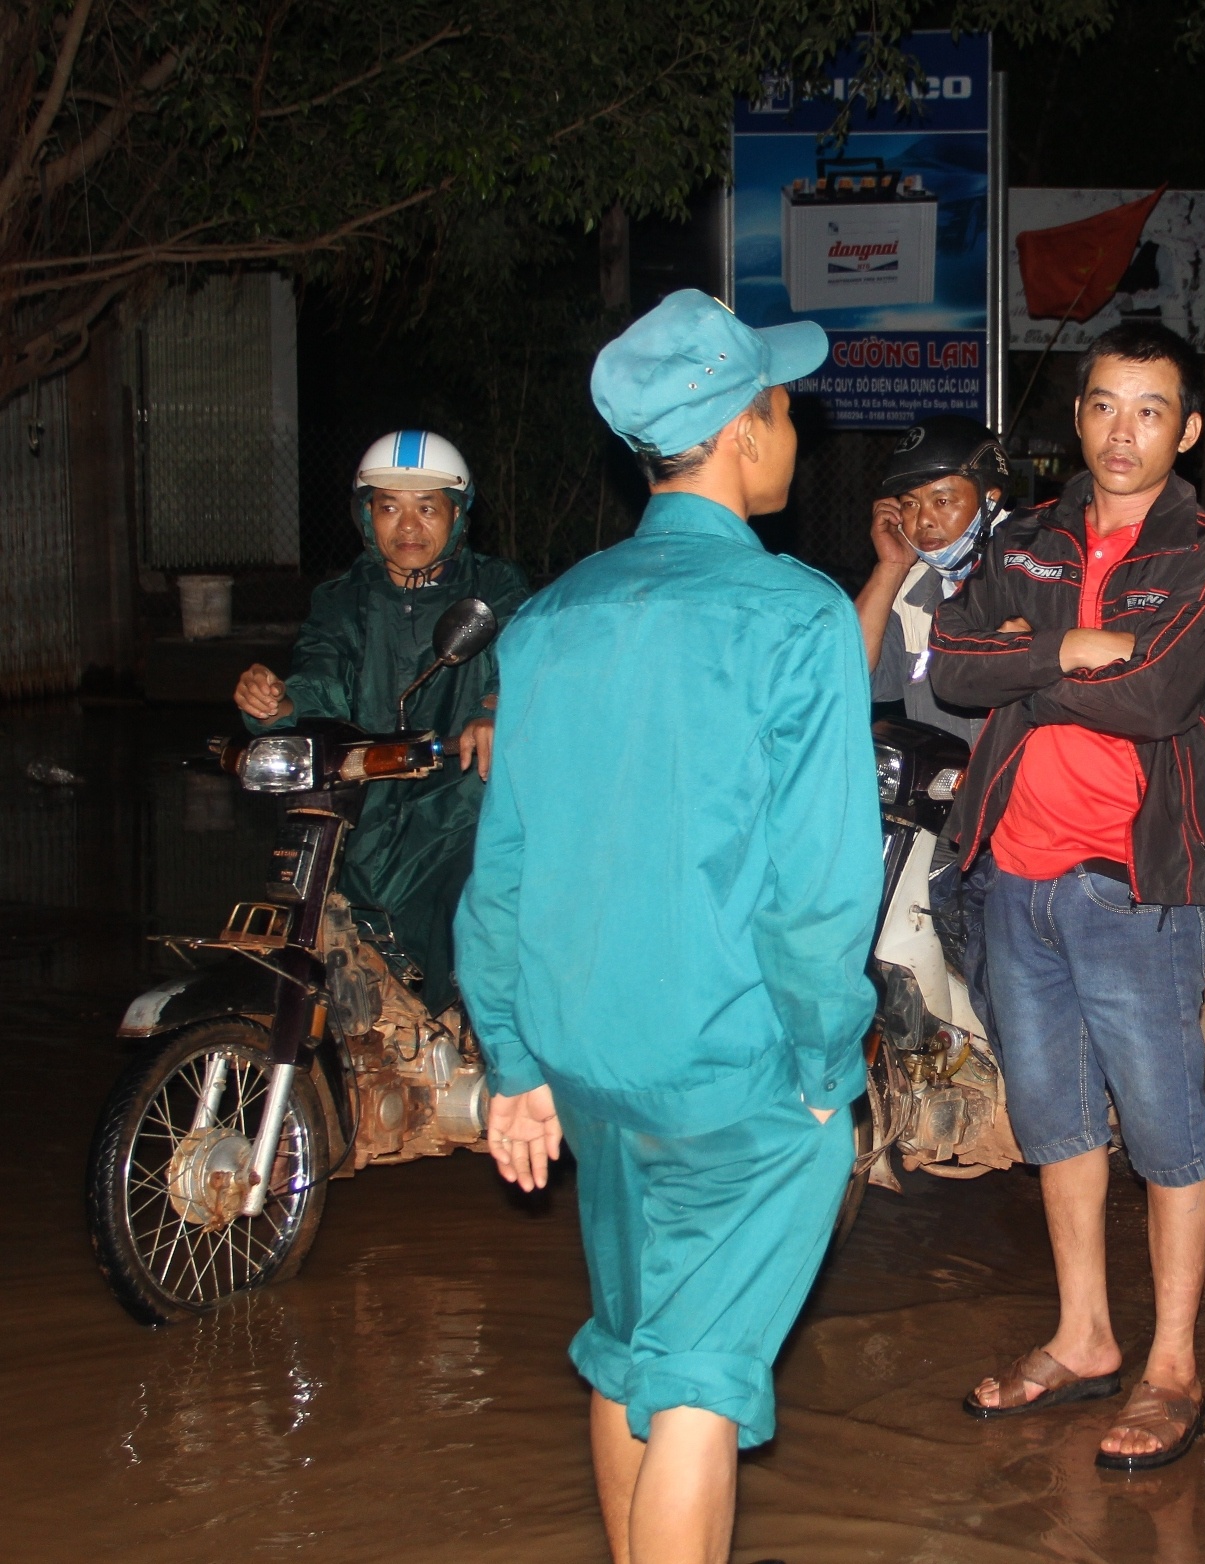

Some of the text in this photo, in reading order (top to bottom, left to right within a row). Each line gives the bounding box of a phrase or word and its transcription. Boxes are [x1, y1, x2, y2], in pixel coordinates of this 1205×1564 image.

[833, 336, 979, 371] CƯỜNG LAN
[893, 378, 909, 393] GIA
[910, 378, 936, 396] DỤNG
[937, 374, 957, 393] CÁC
[958, 378, 979, 396] LOẠI
